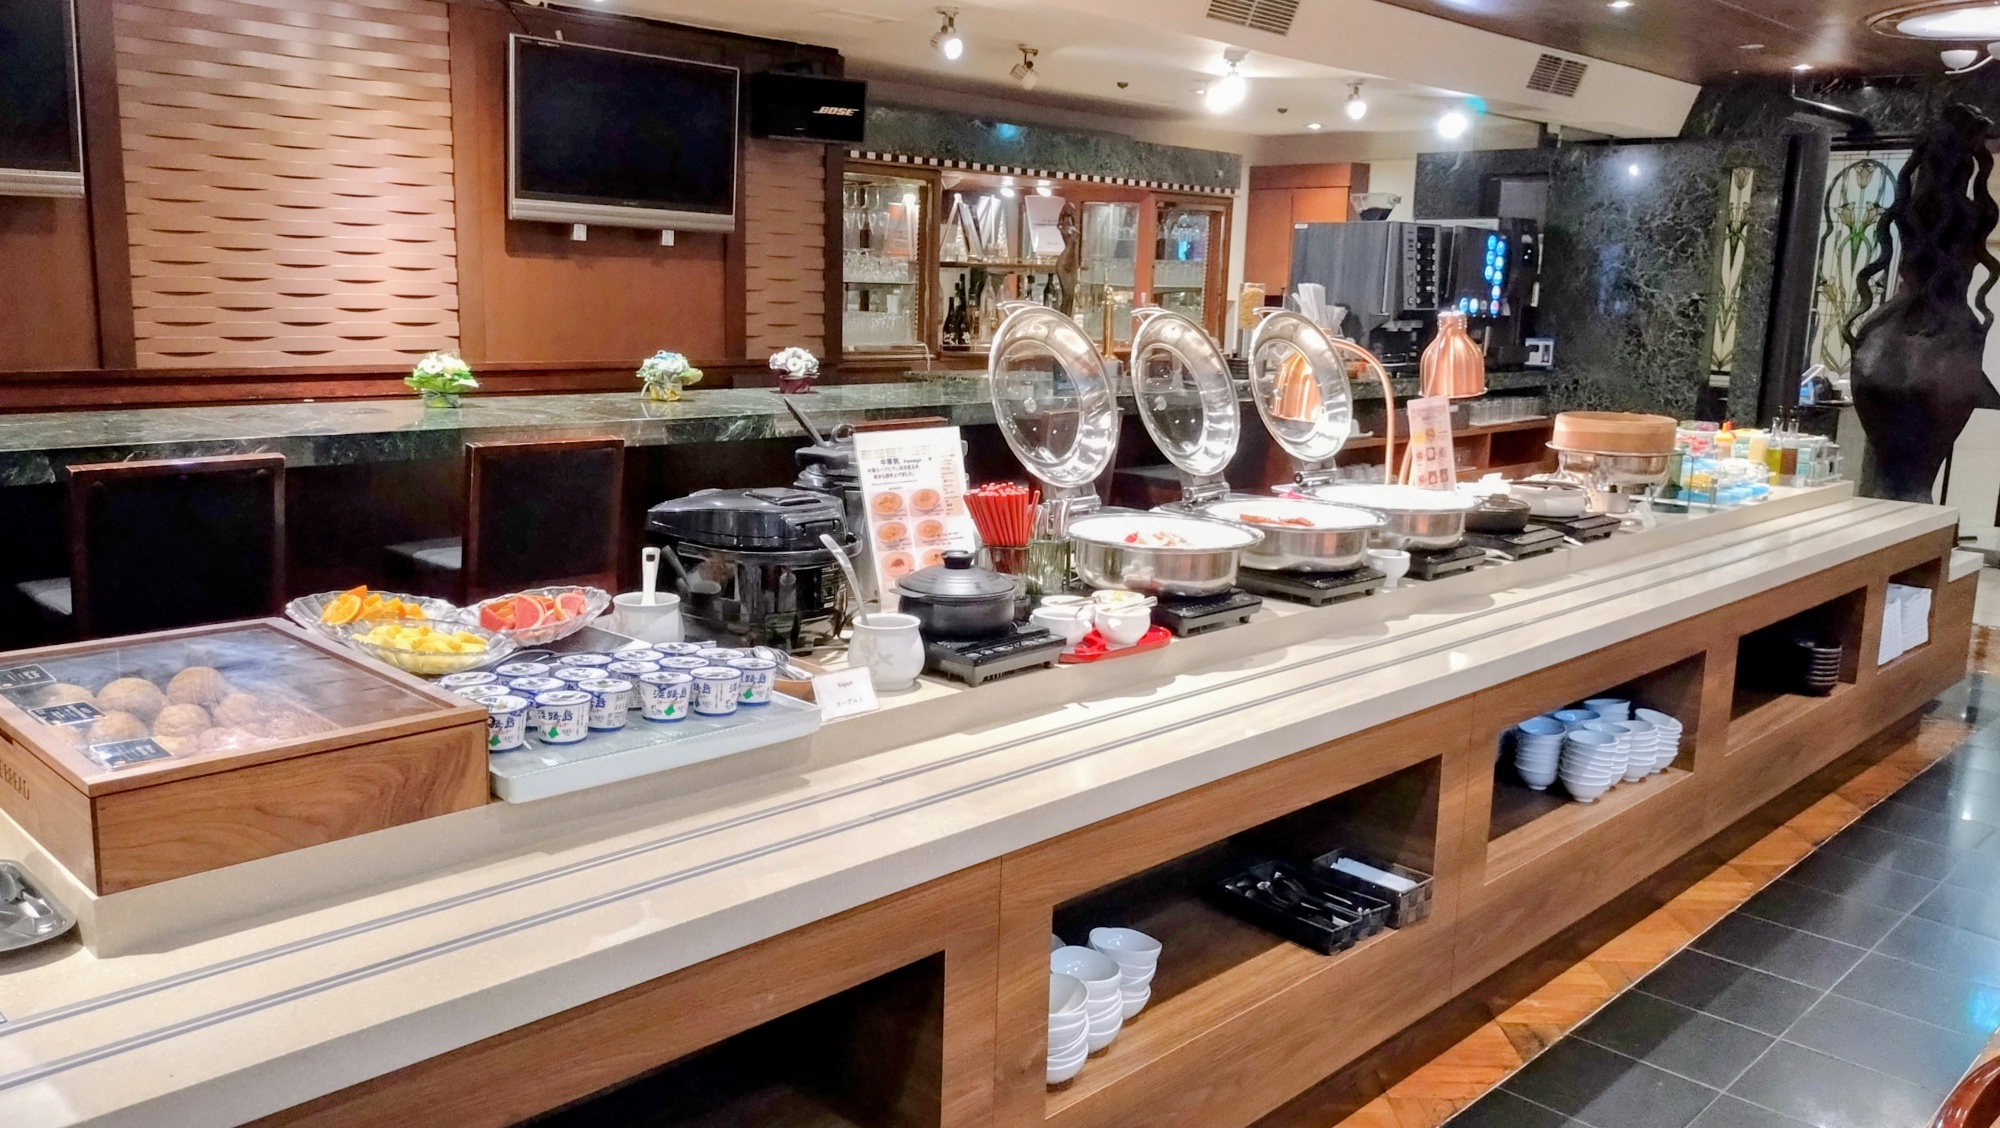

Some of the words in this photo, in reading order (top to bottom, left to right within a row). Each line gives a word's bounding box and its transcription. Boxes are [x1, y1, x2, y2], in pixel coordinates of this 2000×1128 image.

[813, 106, 860, 117] BOSE
[653, 687, 688, 700] 淡路島
[538, 709, 574, 722] 淡路島
